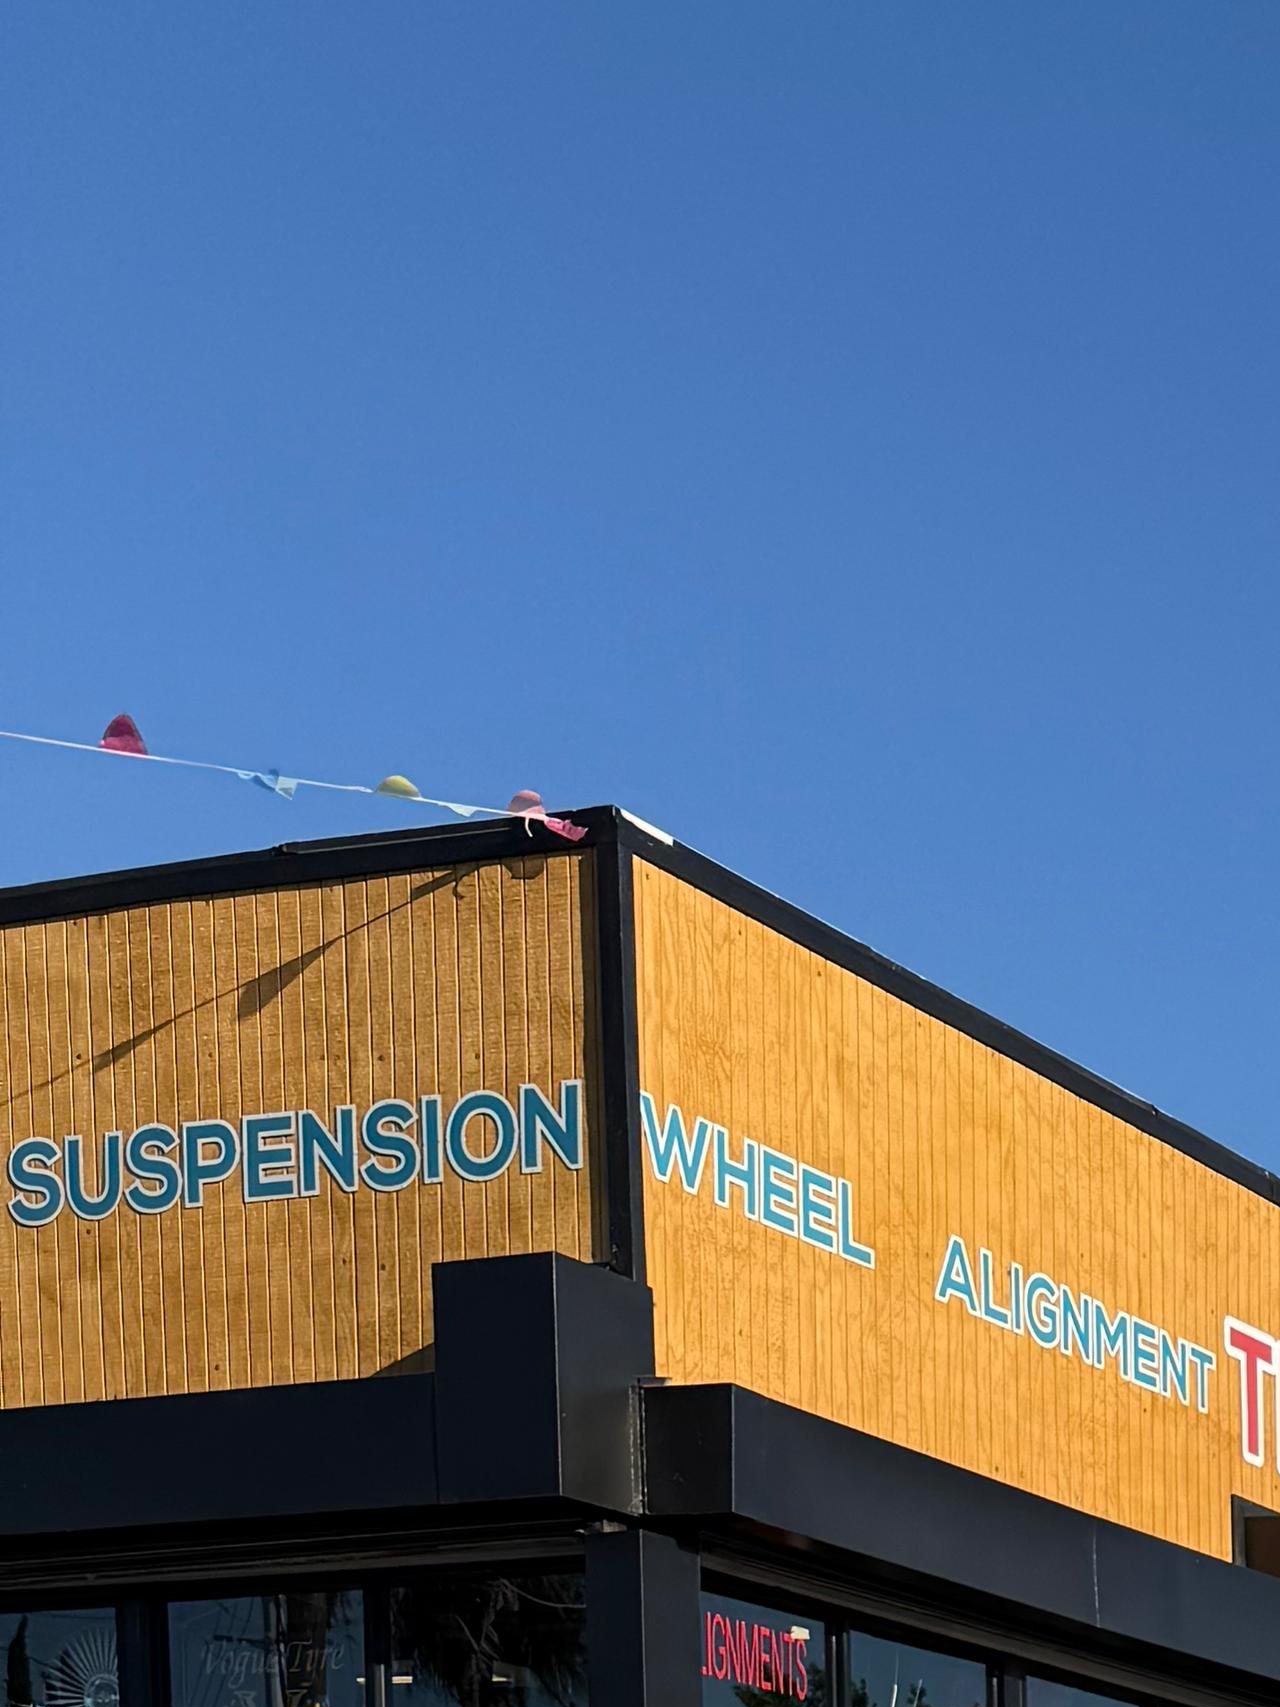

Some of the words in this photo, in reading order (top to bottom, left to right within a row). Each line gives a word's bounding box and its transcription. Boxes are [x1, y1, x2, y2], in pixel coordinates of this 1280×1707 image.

[8, 1078, 584, 1227] SUSPENSION
[640, 1091, 875, 1270] WHEEL
[934, 1234, 1216, 1414] ALIGNMENT
[700, 1611, 809, 1702] IGNMENTS
